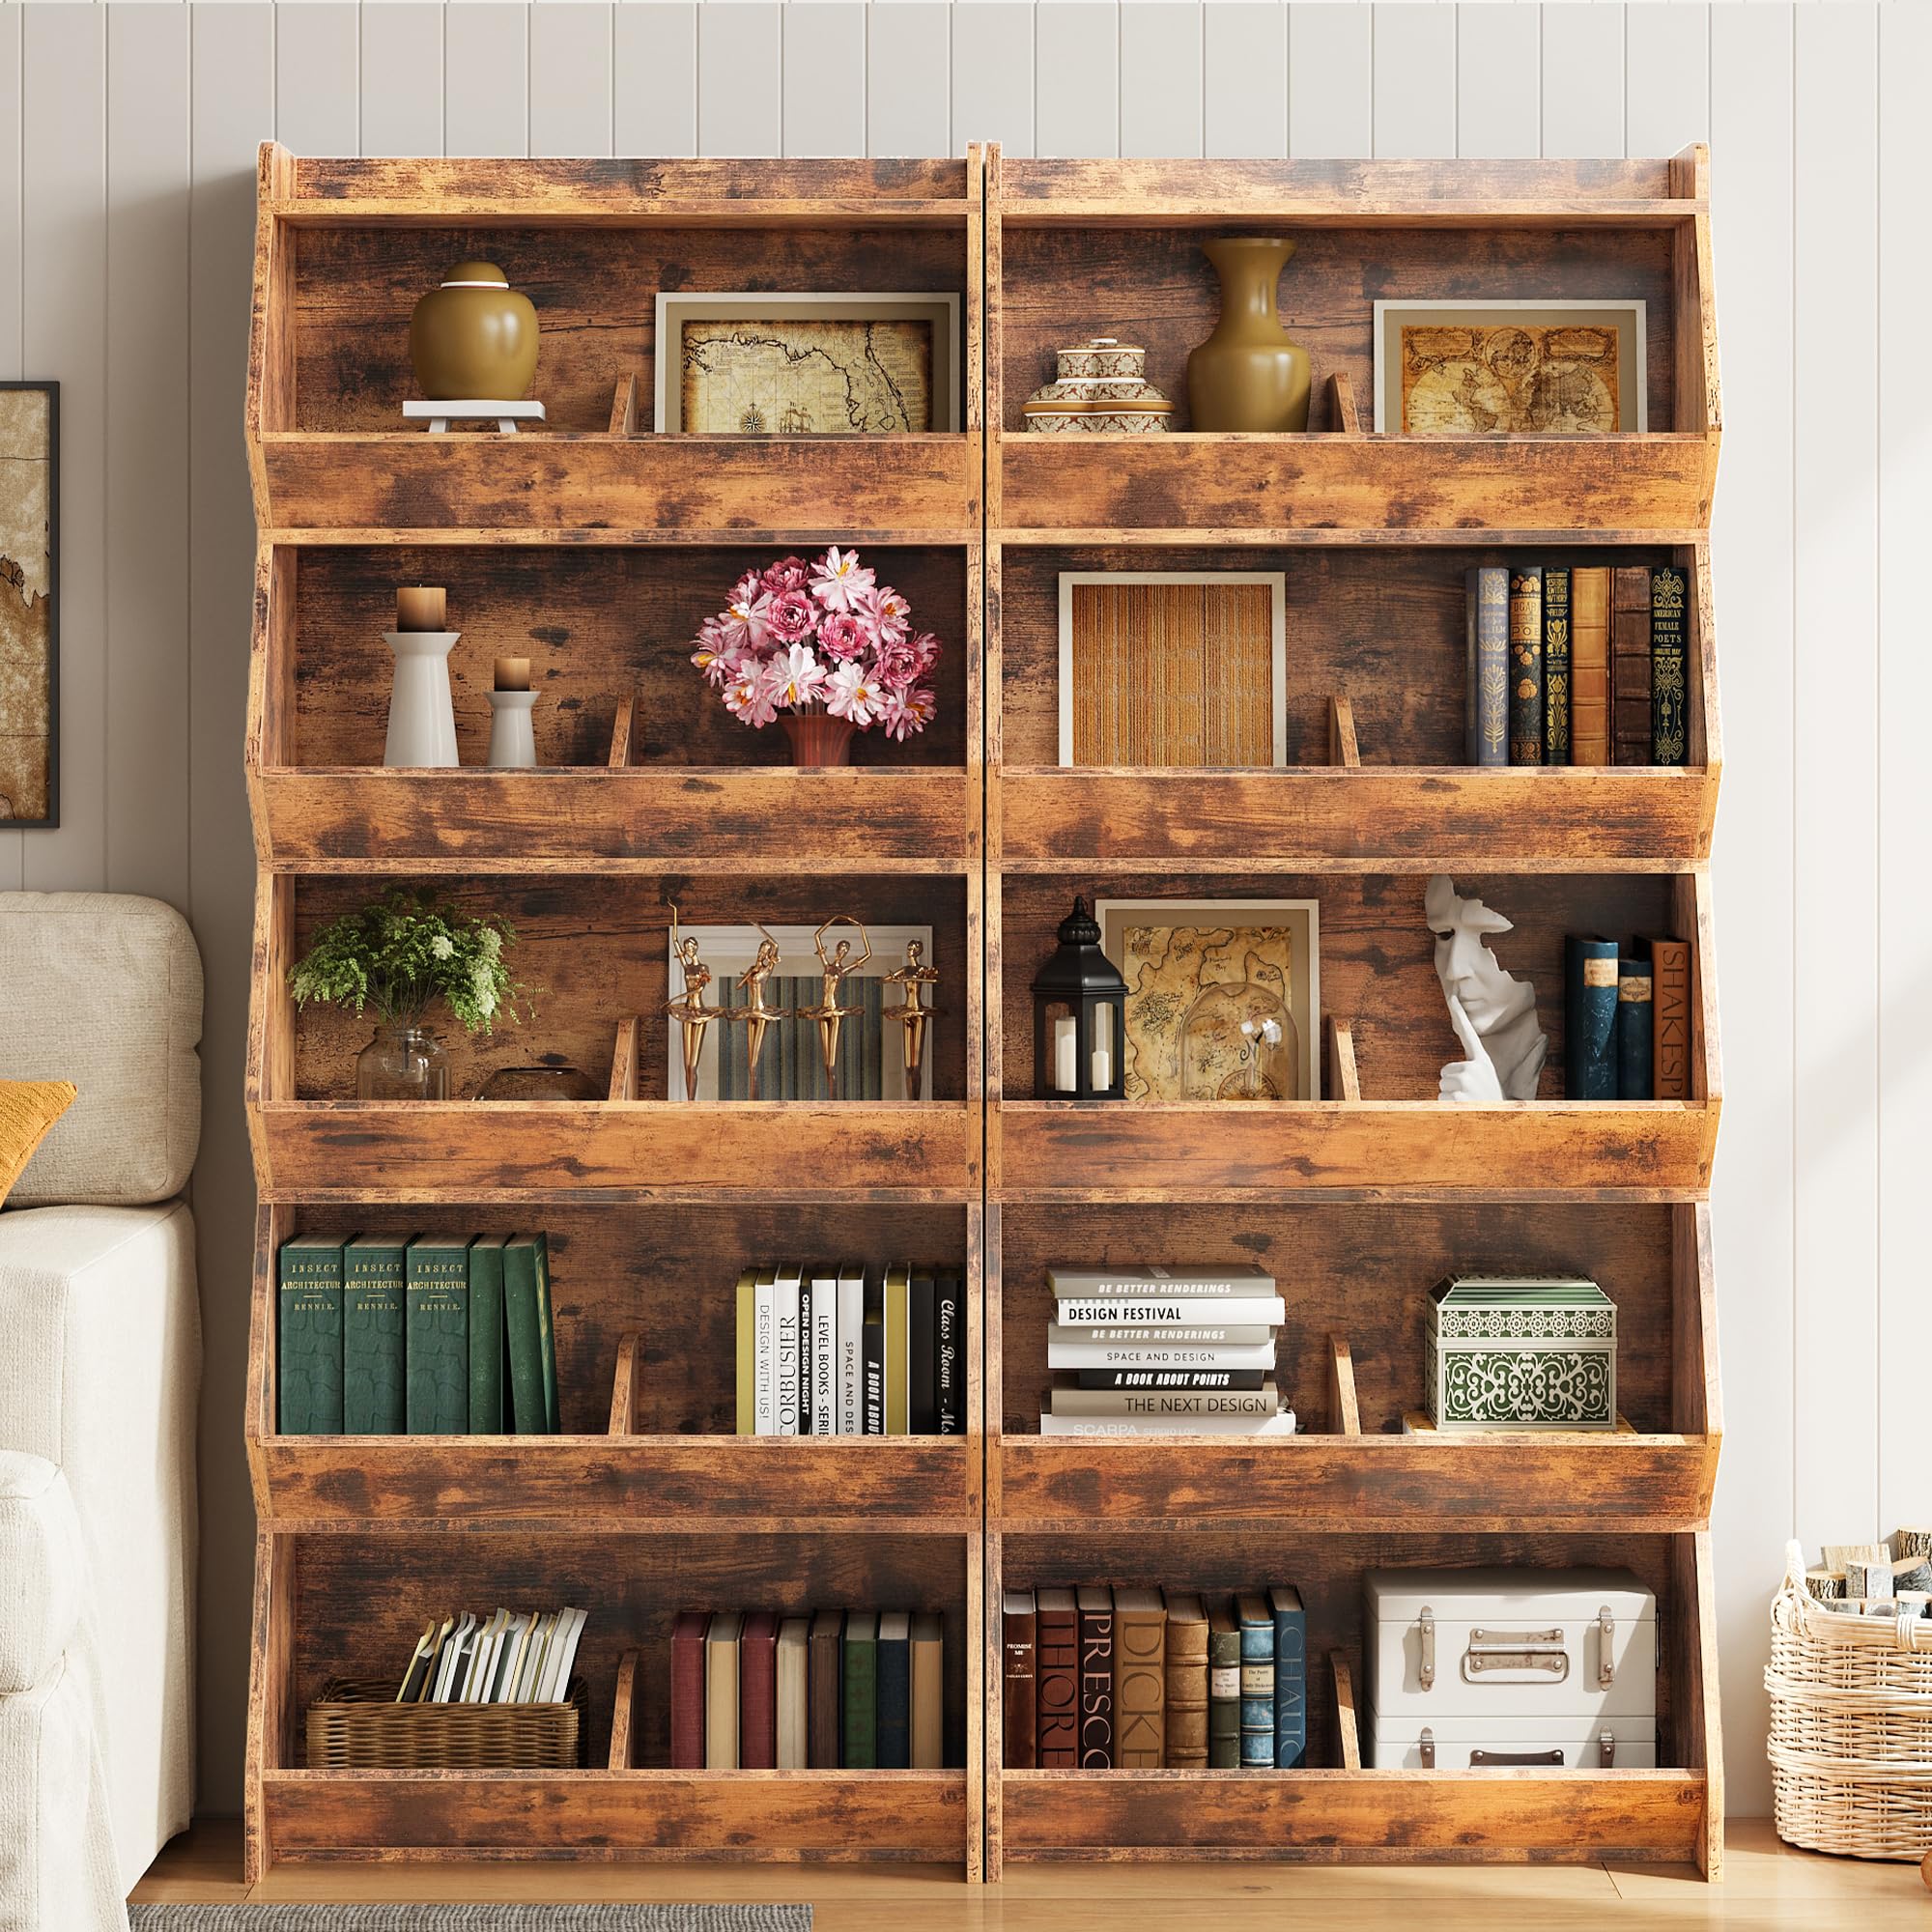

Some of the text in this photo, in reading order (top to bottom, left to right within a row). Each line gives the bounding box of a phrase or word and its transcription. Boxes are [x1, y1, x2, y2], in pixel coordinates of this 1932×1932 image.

[1653, 609, 1682, 618] AMERICAN
[1654, 621, 1680, 631] FEMALE
[1653, 634, 1682, 643] POETS
[1662, 950, 1685, 1100] SHAKESP
[292, 1264, 338, 1273] INSECT
[355, 1264, 401, 1273] INSECT
[417, 1264, 464, 1273] INSECT
[1097, 1284, 1232, 1293] BE BETTER RENDERINGS
[940, 1299, 954, 1340] Class
[1068, 1308, 1181, 1321] DESIGN FESTIVAL
[817, 1315, 829, 1350] LEVEL
[1092, 1329, 1226, 1340] BE BETTER RENDERINGS
[759, 1305, 769, 1419] DESIGN WITH US!
[844, 1341, 853, 1378] SPACE
[1107, 1352, 1215, 1361] SPACE AND DESIGN
[940, 1345, 954, 1389] Room
[817, 1353, 829, 1396] BOOKS
[1115, 1374, 1231, 1385] A BOOK ABOUT POINTS
[867, 1372, 878, 1401] BOOK
[844, 1381, 853, 1406] AND
[1125, 1398, 1267, 1412] THE NEXT DESIGN
[1073, 1424, 1137, 1435] SCARPA
